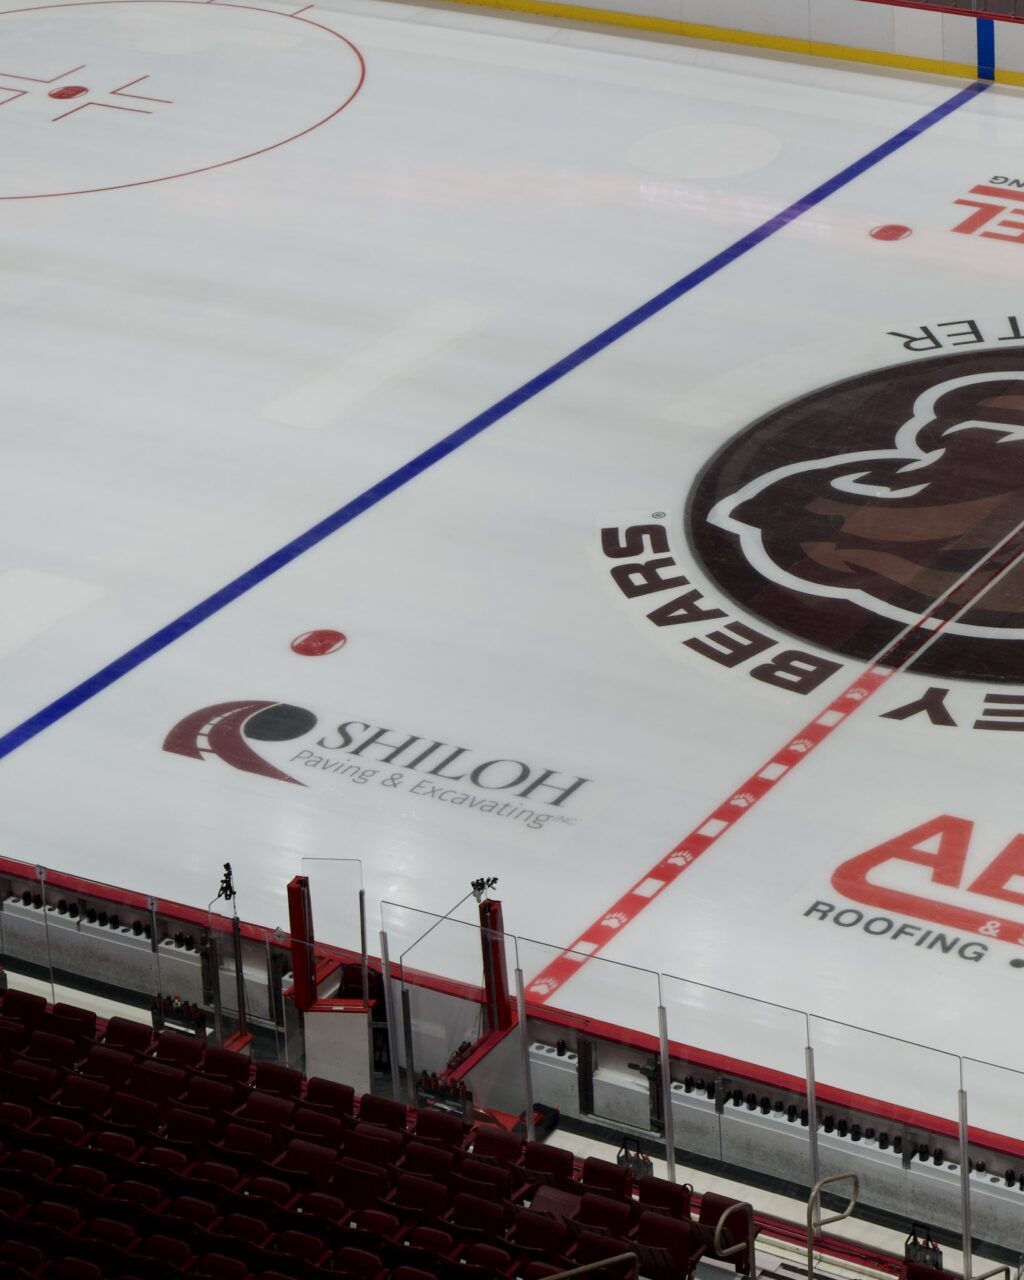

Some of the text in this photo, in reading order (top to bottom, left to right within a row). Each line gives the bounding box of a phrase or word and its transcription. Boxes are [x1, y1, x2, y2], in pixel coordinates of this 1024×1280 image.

[601, 523, 844, 696] BEARS
[290, 749, 377, 785] Paving
[380, 772, 405, 789] &
[409, 778, 555, 831] Excavating
[316, 720, 595, 808] SHILOH
[803, 900, 990, 964] ROOFING
[977, 920, 1002, 939] &
